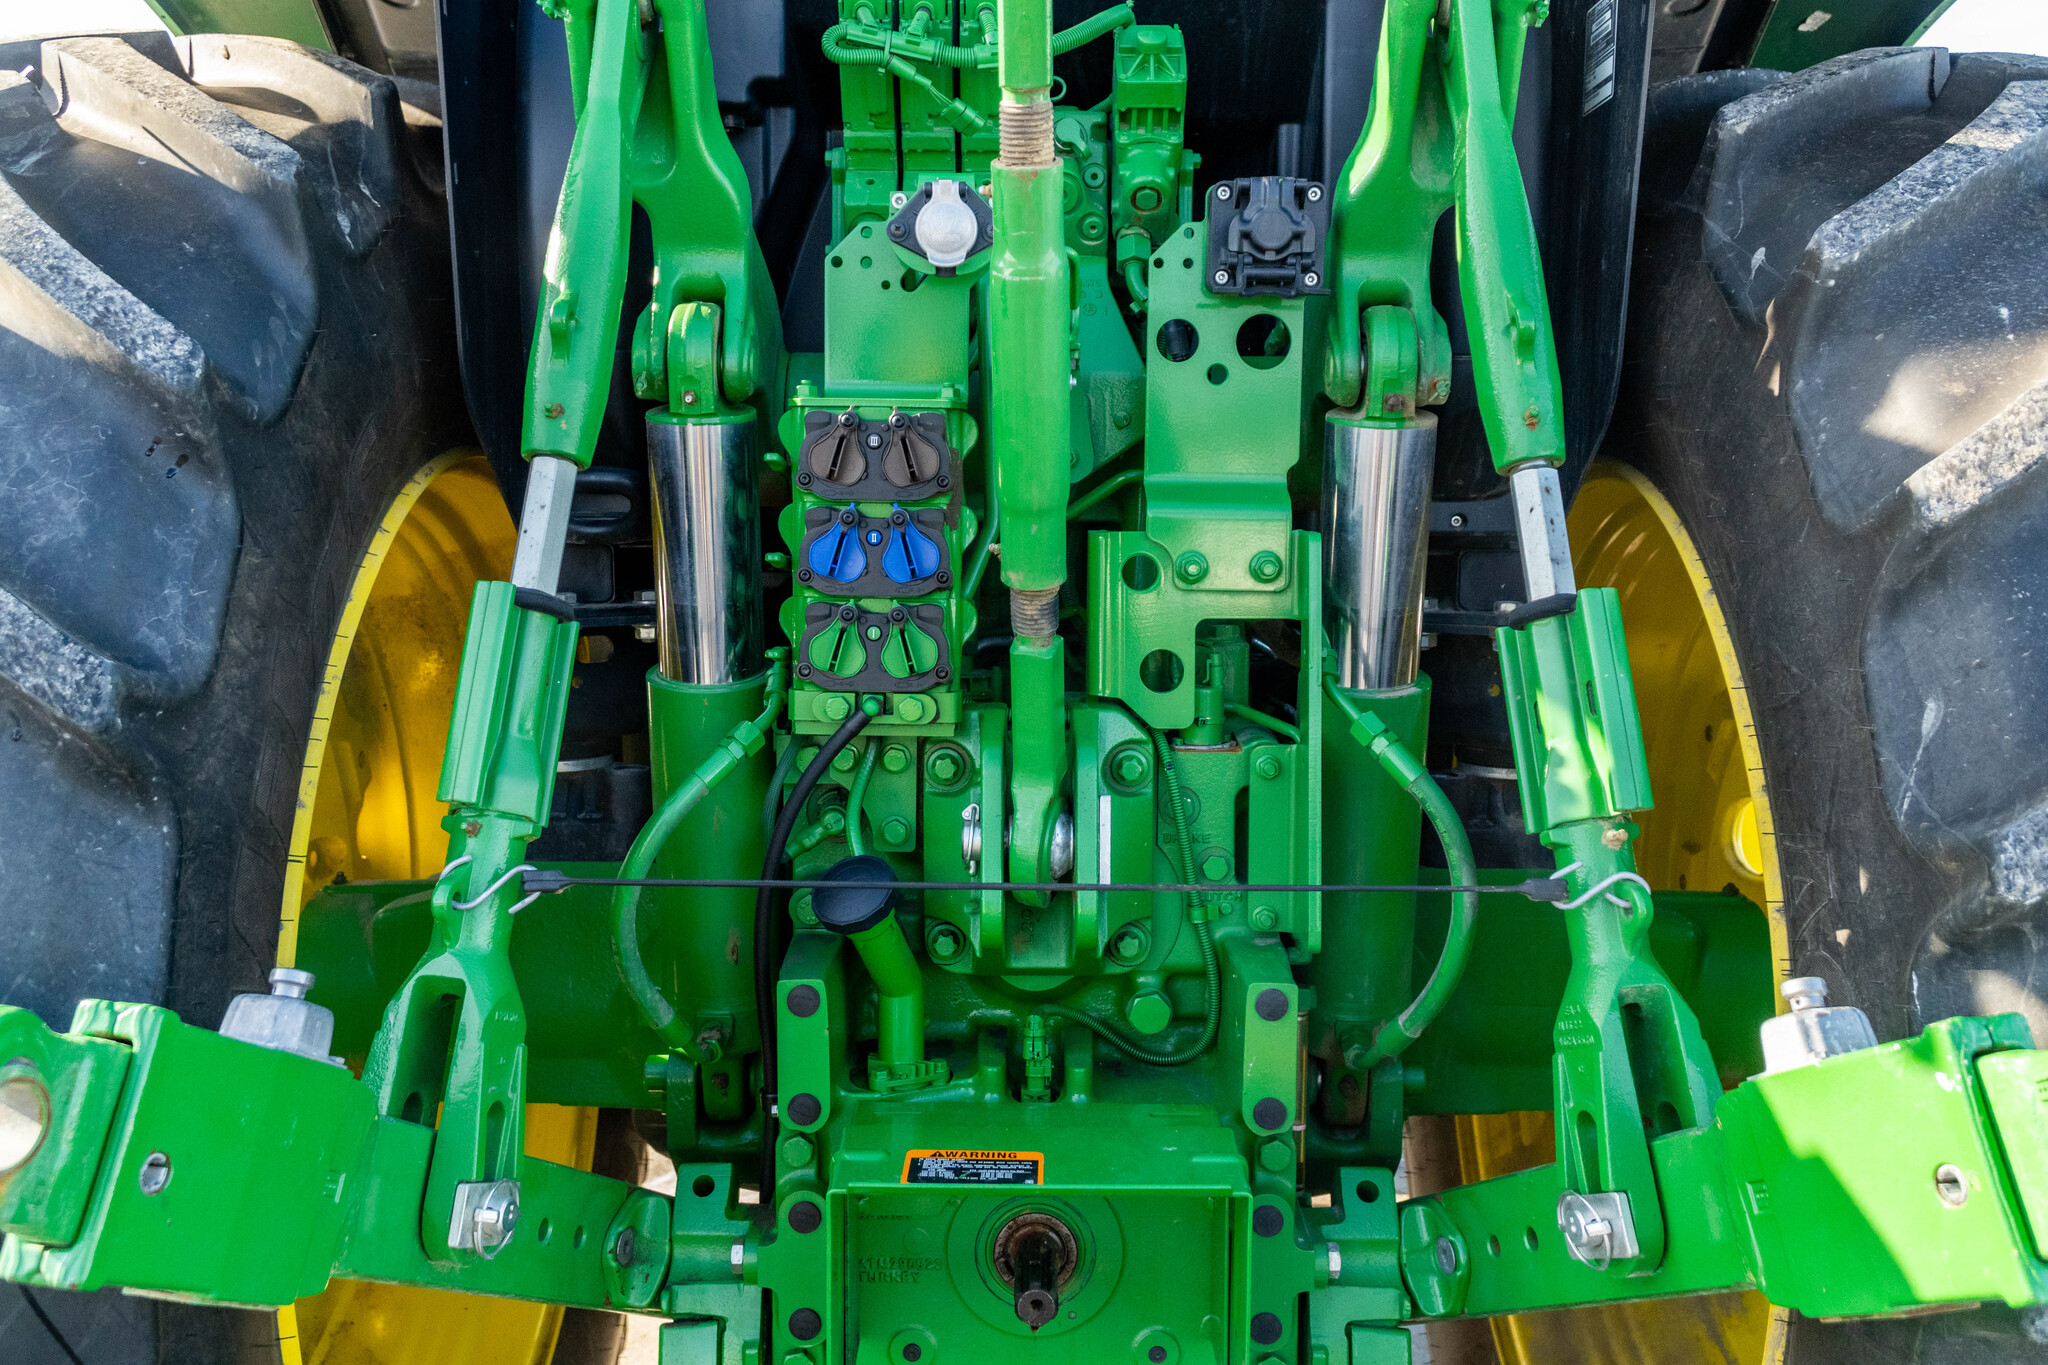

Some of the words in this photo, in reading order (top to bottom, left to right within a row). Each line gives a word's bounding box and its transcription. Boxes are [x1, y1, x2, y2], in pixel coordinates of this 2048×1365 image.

[1163, 832, 1211, 844] BRKE
[945, 1151, 1017, 1159] WARNING
[858, 1271, 920, 1283] TURKEY
